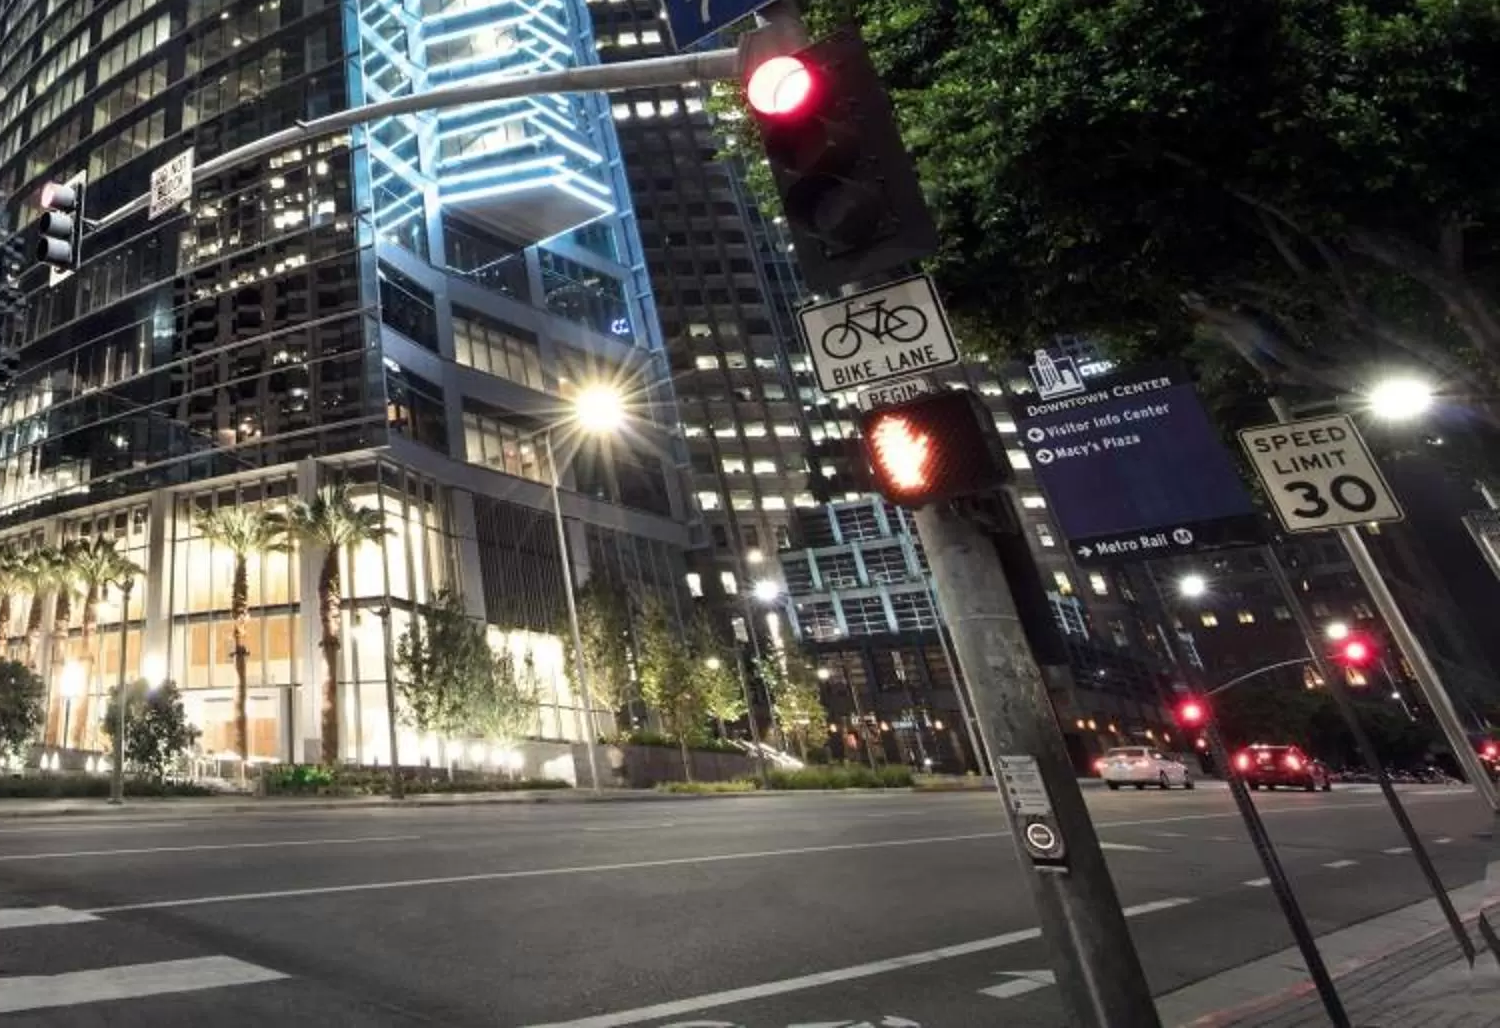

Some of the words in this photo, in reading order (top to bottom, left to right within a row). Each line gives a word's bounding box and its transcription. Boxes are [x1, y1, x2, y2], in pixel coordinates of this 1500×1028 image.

[832, 359, 877, 385] BIKE
[885, 345, 939, 372] LANE
[868, 381, 918, 408] BEGIN
[1045, 420, 1089, 439] Visitor
[1093, 414, 1121, 428] Info
[1123, 403, 1169, 421] Center
[1055, 441, 1101, 459] Macy's
[1103, 434, 1141, 450] Plaza
[1254, 426, 1346, 453] SPEED
[1272, 450, 1346, 474] LIMIT
[1284, 475, 1376, 518] 30
[1095, 540, 1139, 555] Metro
[1140, 533, 1168, 549] Rail
